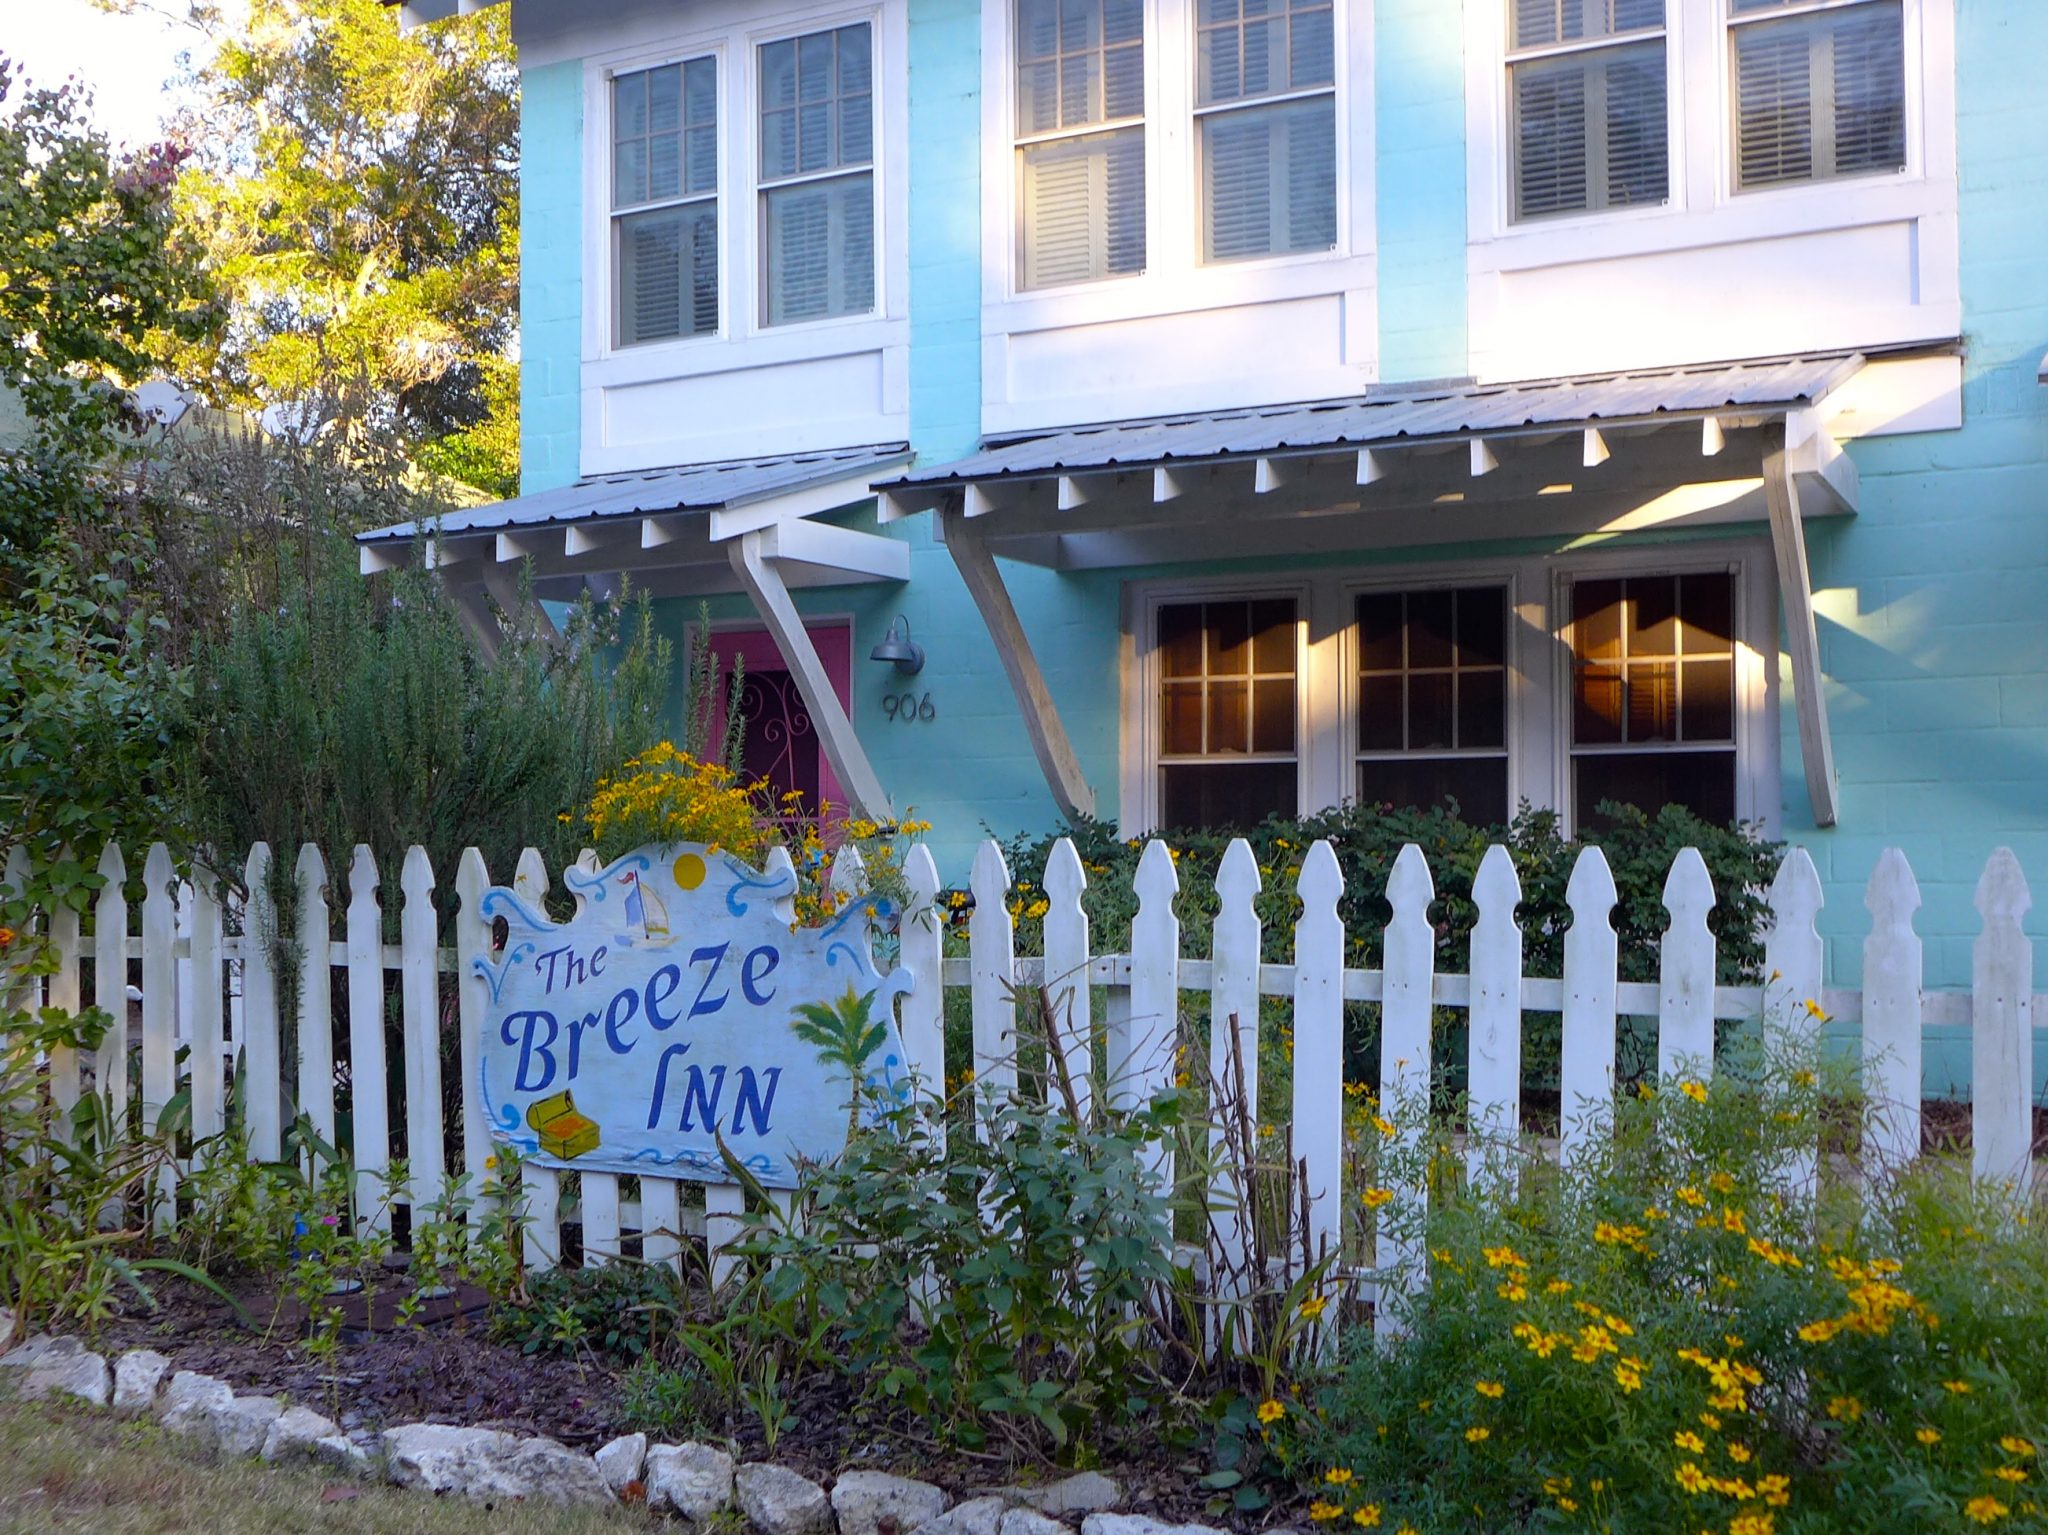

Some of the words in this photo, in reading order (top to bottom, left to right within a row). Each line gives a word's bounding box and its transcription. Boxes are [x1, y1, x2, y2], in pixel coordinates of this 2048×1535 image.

[883, 692, 935, 722] 906
[535, 944, 608, 995] The
[500, 940, 780, 1092] Breeze
[646, 1042, 783, 1137] INN
